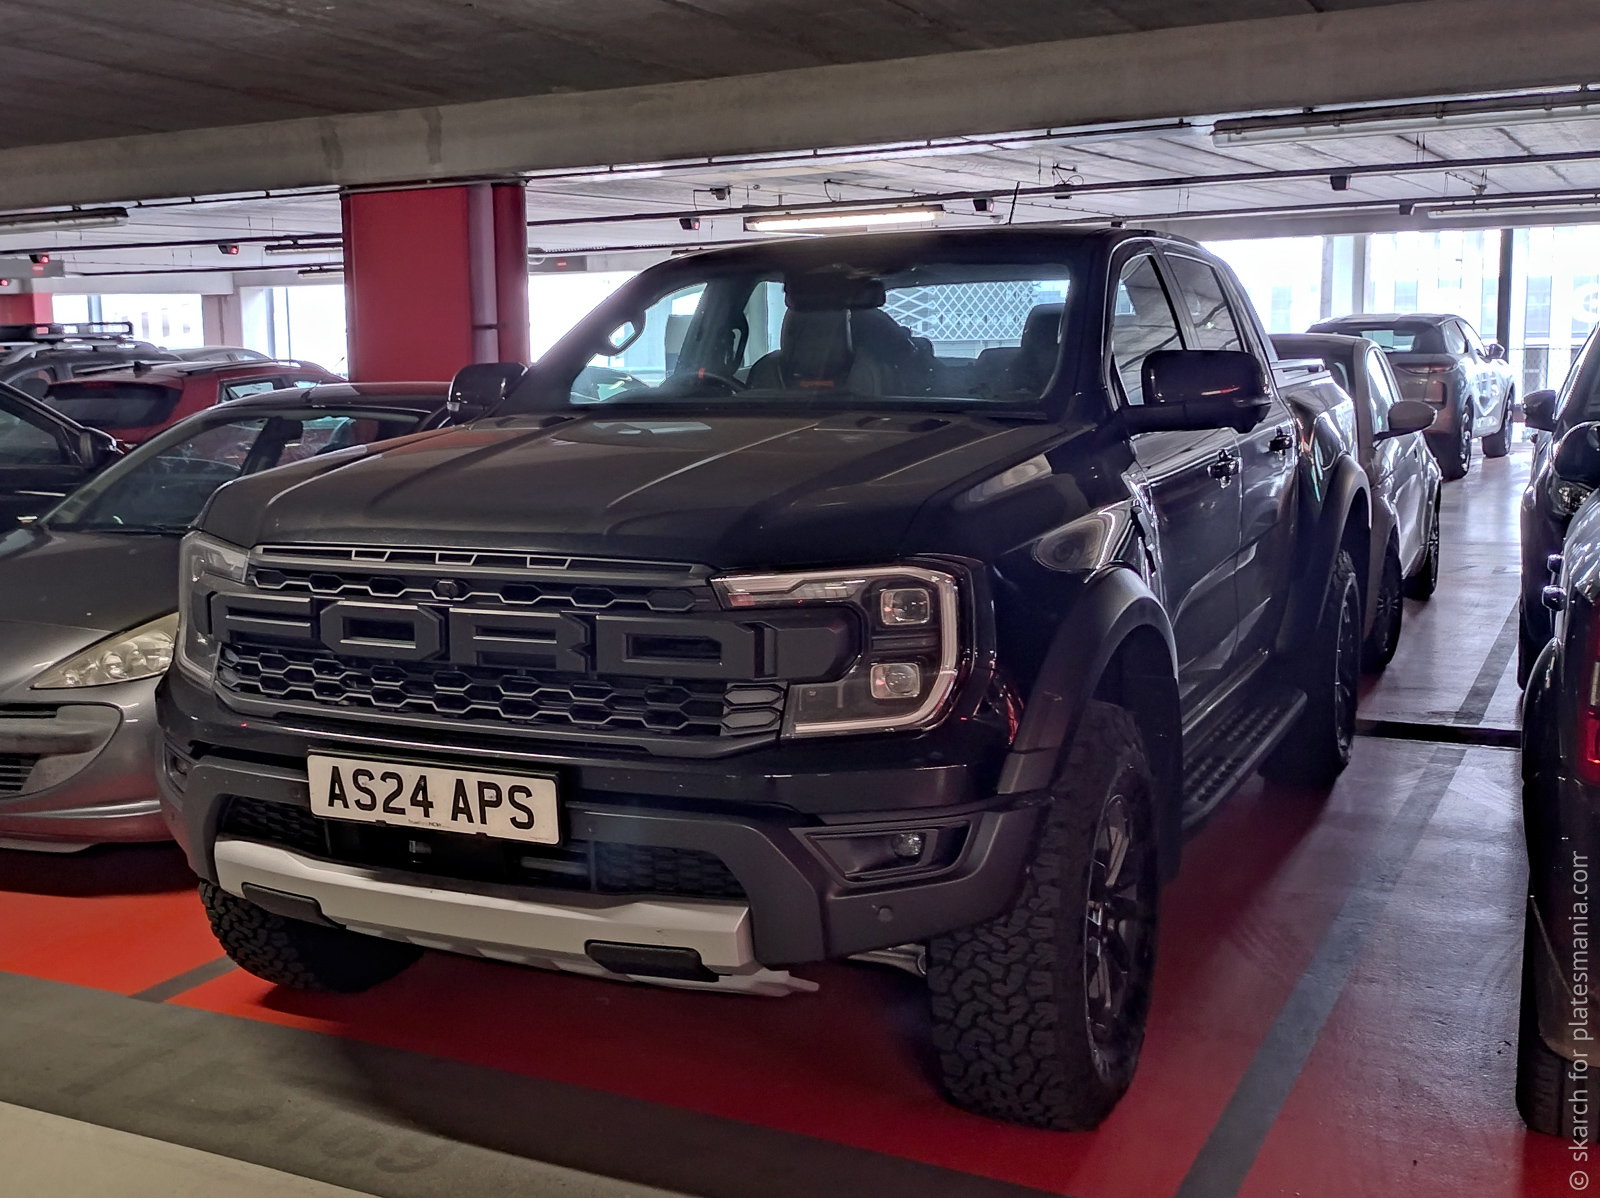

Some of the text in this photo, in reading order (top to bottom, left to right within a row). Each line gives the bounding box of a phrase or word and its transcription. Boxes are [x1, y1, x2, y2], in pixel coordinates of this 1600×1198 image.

[209, 590, 756, 679] FORD
[328, 766, 535, 830] AS24 APS
